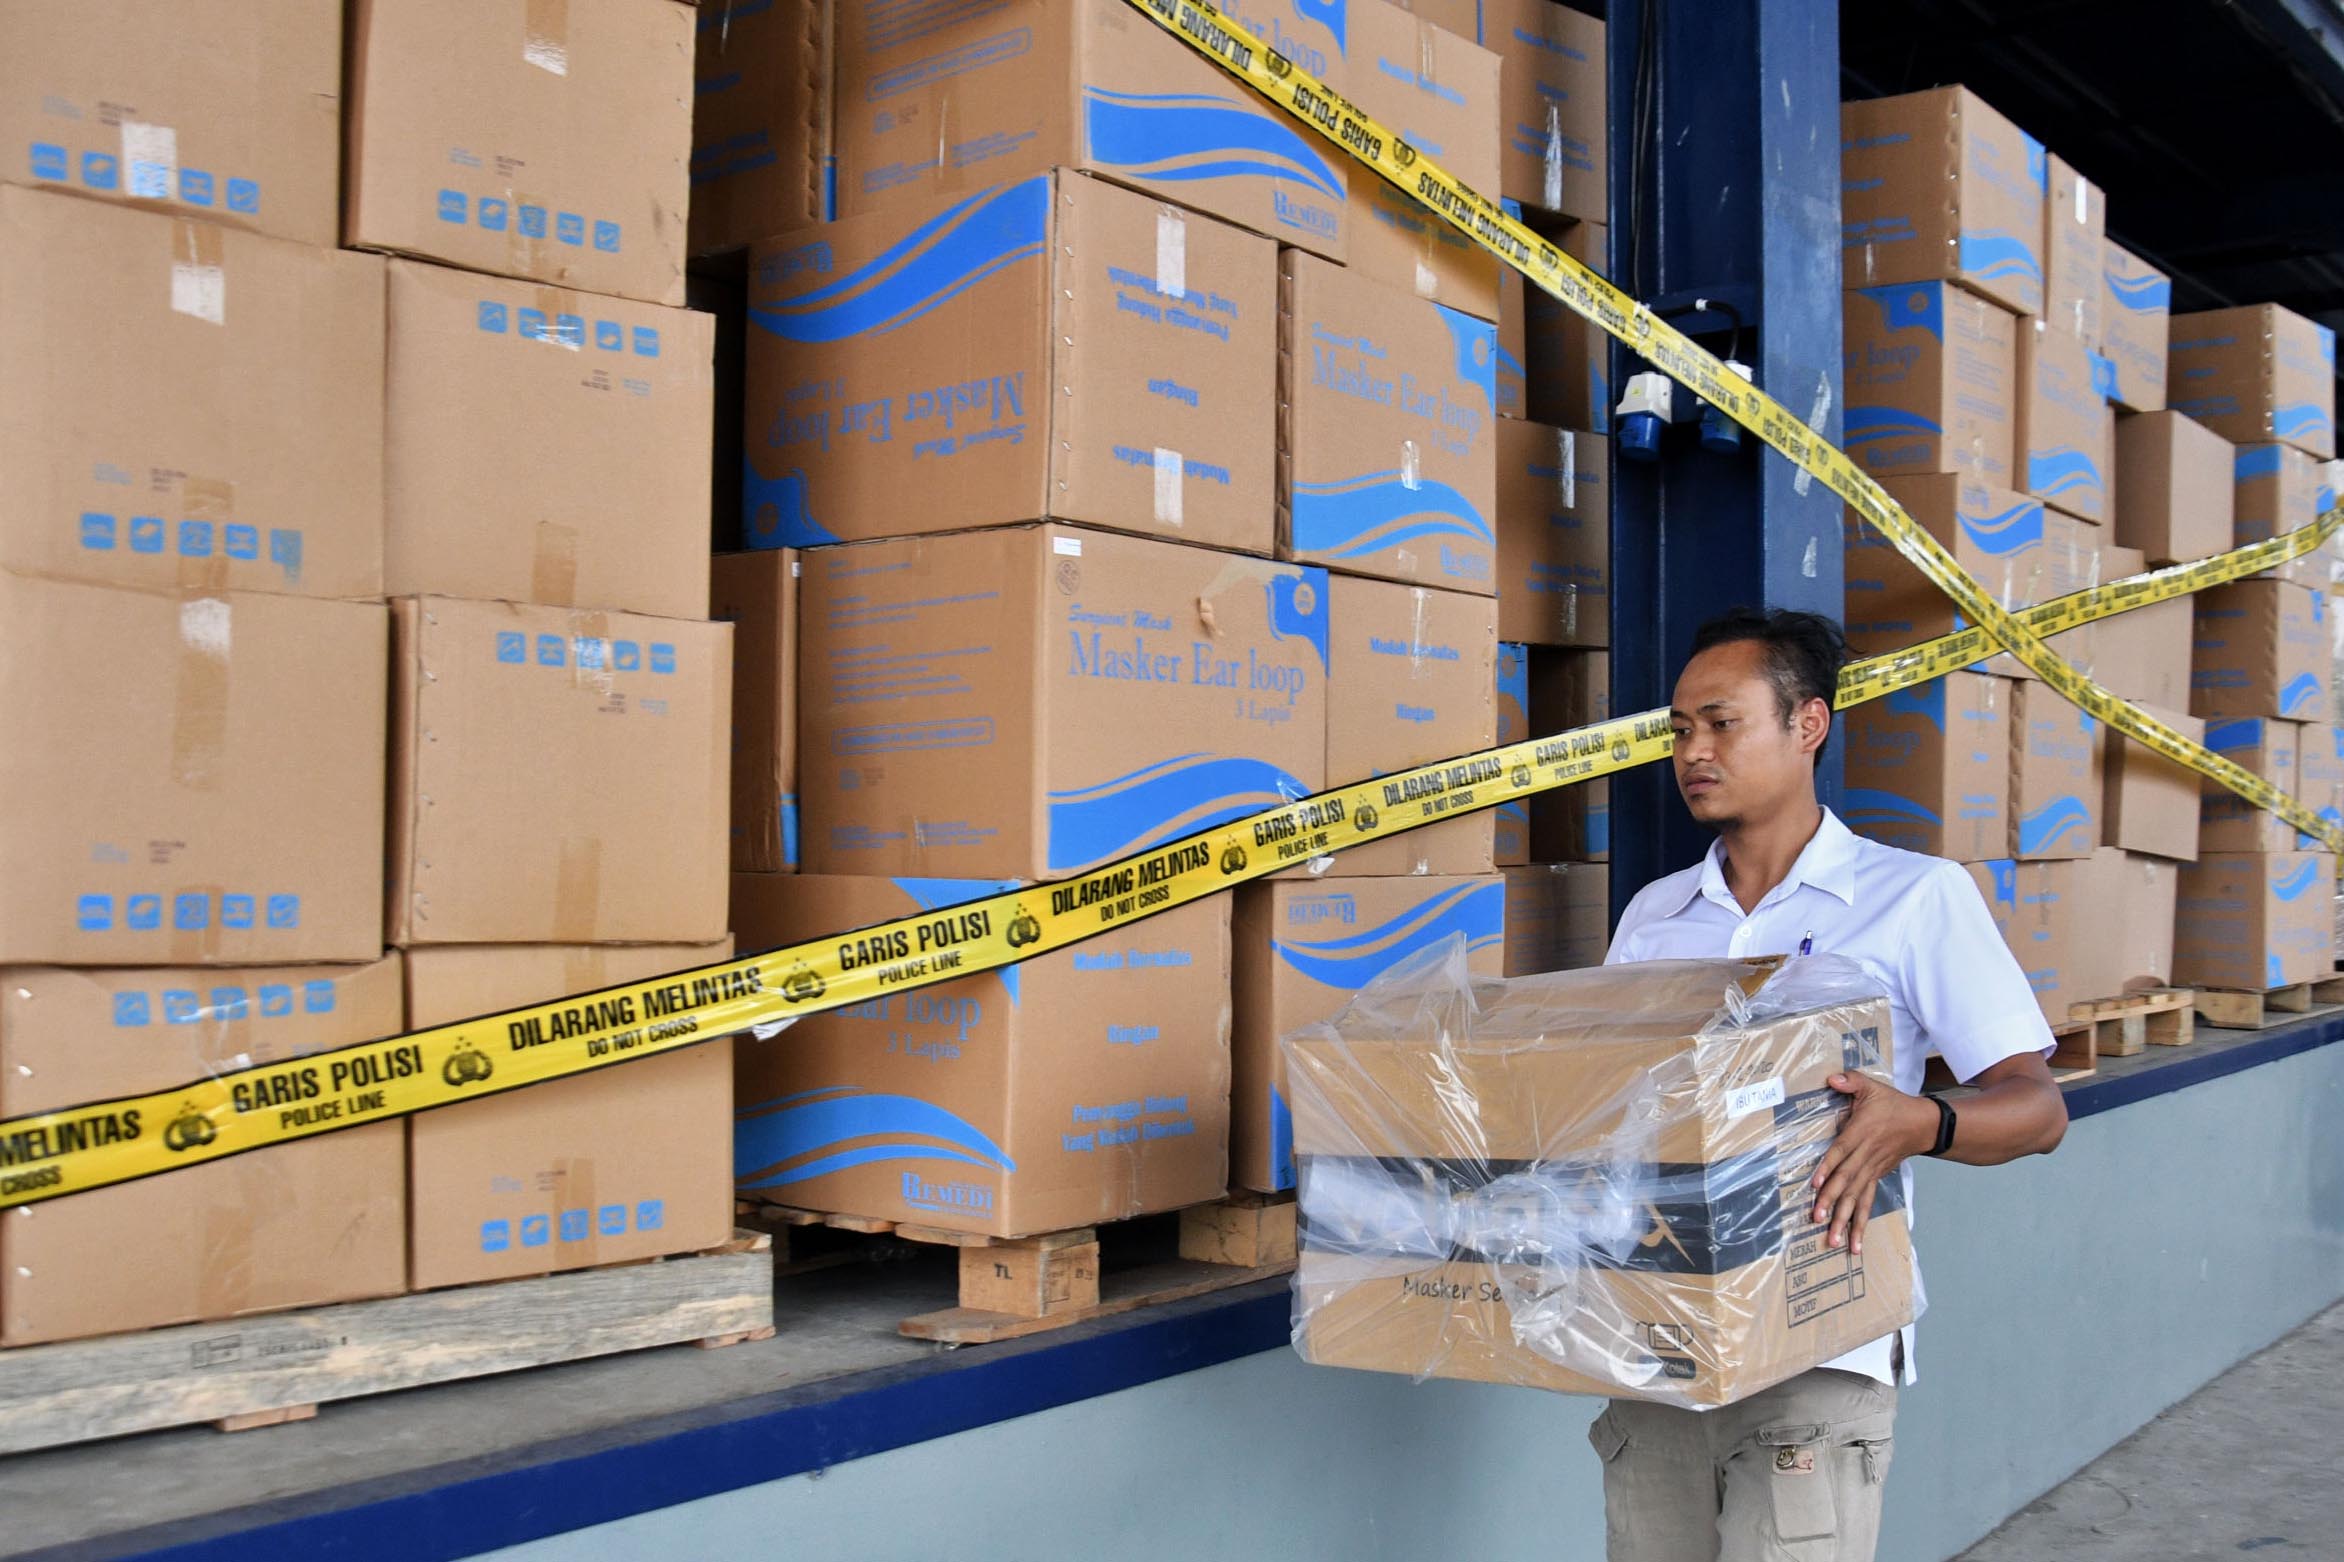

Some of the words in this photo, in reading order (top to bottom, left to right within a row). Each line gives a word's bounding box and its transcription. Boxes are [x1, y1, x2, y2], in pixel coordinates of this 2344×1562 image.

[1181, 4, 1252, 71] DILARANG
[1292, 83, 1338, 132] POLISI
[1341, 117, 1383, 161] GARIS
[1418, 172, 1475, 227] MELINTAS
[1475, 212, 1531, 267] DILARANG
[902, 371, 1025, 430] Masker
[1312, 345, 1394, 408] Masker
[1401, 373, 1437, 420] Ear
[768, 406, 831, 455] loop
[838, 398, 893, 443] Ear
[1068, 629, 1182, 684] Masker
[1191, 641, 1242, 688] Ear
[1248, 646, 1306, 705] loop
[1536, 741, 1570, 768] GARIS
[1571, 731, 1606, 758] POLISI
[1634, 716, 1674, 743] DILARAN
[1383, 770, 1446, 808] DILARANG
[1446, 757, 1503, 792] MELINTAS
[1422, 800, 1434, 817] DO
[1433, 794, 1451, 813] NOT
[1450, 790, 1474, 810] CROSS
[1254, 813, 1297, 848] GARIS
[1299, 798, 1346, 832] POLISI
[1277, 839, 1308, 861] POLICE
[1309, 831, 1329, 852] LINE
[1051, 872, 1134, 917] DILARANG
[1137, 841, 1210, 886] MELINTAS
[1100, 903, 1116, 922] DO
[1117, 895, 1137, 917] NOT
[1138, 884, 1170, 910] CROSS
[839, 930, 910, 972] GARIS
[917, 910, 992, 952] POLISI
[878, 958, 927, 986] POLICE
[931, 950, 963, 974] LINE
[508, 995, 637, 1052] DILARANG
[641, 966, 763, 1020] MELINTAS
[905, 990, 982, 1041] loop
[586, 1037, 610, 1059] DO
[612, 1029, 644, 1051] NOT
[647, 1015, 699, 1044] CROSS
[888, 1032, 898, 1054] 3
[904, 1033, 961, 1064] Lapis
[231, 1068, 321, 1114] GARIS
[330, 1044, 425, 1093] POLISI
[280, 1101, 342, 1130] POLICE
[348, 1090, 387, 1115] LINE
[0, 1109, 142, 1167] MELINTAS
[1, 1164, 62, 1196] CROSS
[1403, 1275, 1473, 1301] Masker
[1794, 1297, 1817, 1318] MOTIF
